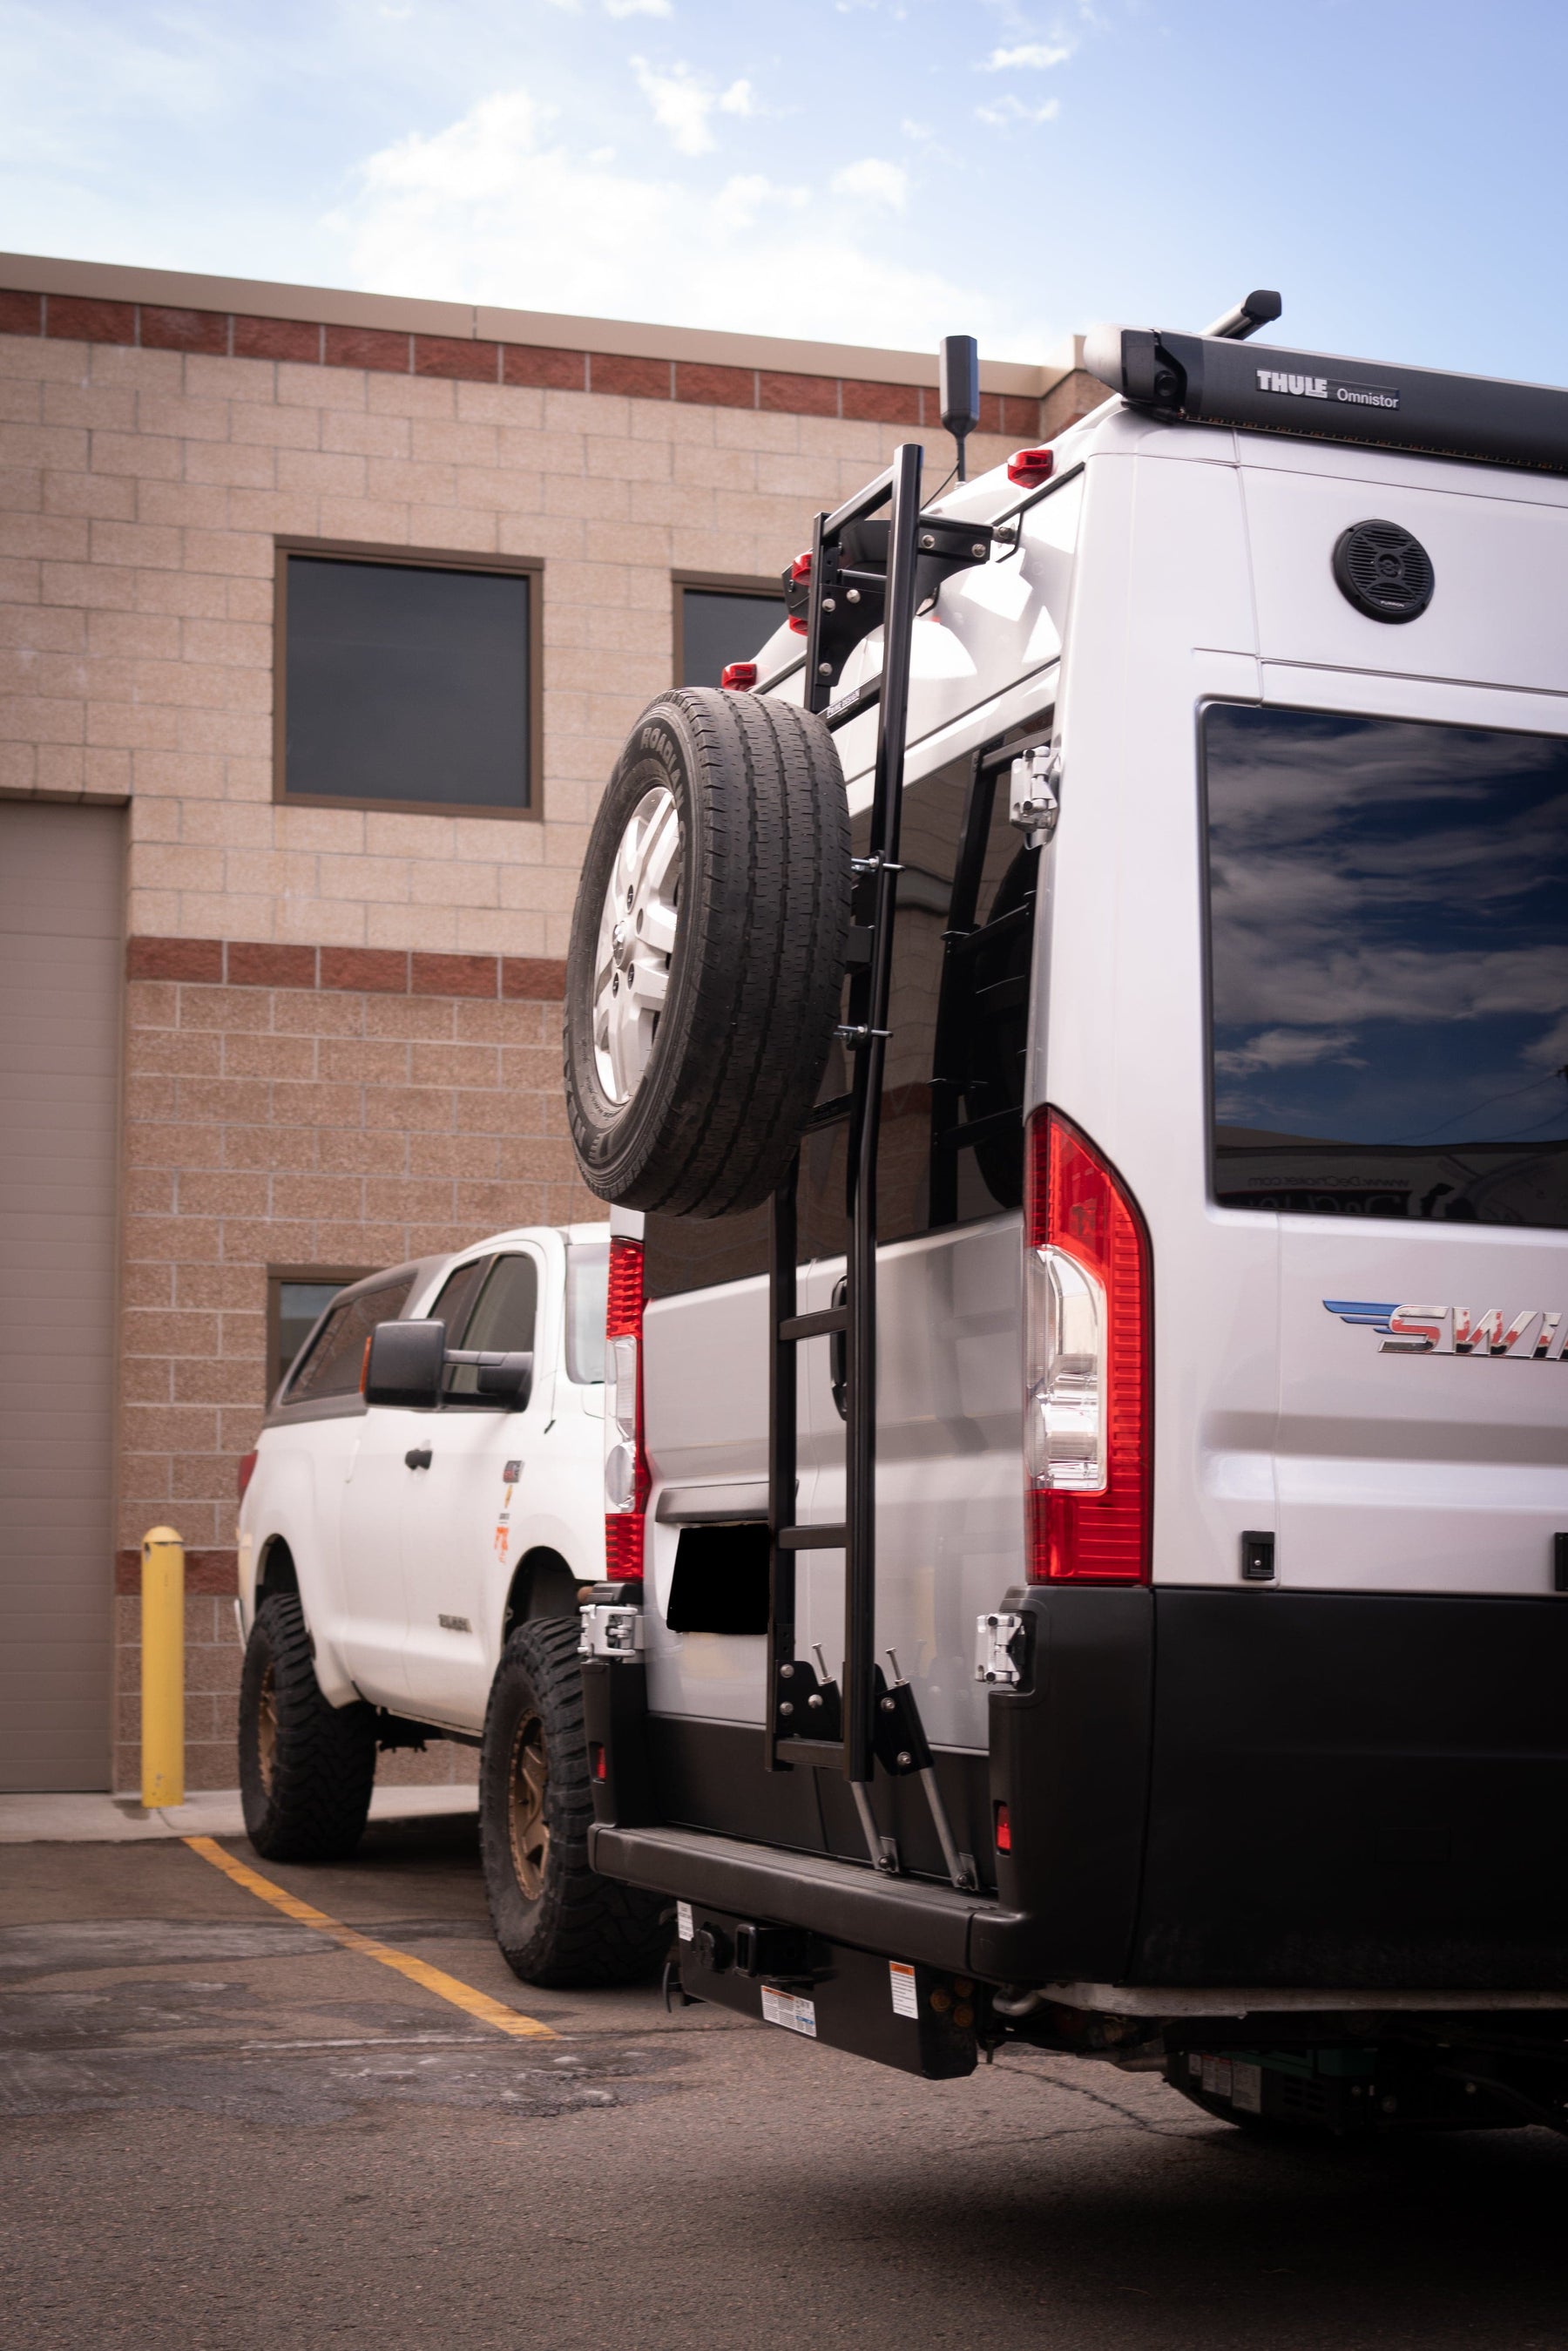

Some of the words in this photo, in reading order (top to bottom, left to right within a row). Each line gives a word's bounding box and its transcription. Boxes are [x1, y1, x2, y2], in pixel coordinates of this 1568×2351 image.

[1257, 370, 1328, 398] THULE
[1336, 388, 1400, 409] Omnistor
[1378, 1304, 1568, 1361] SWI
